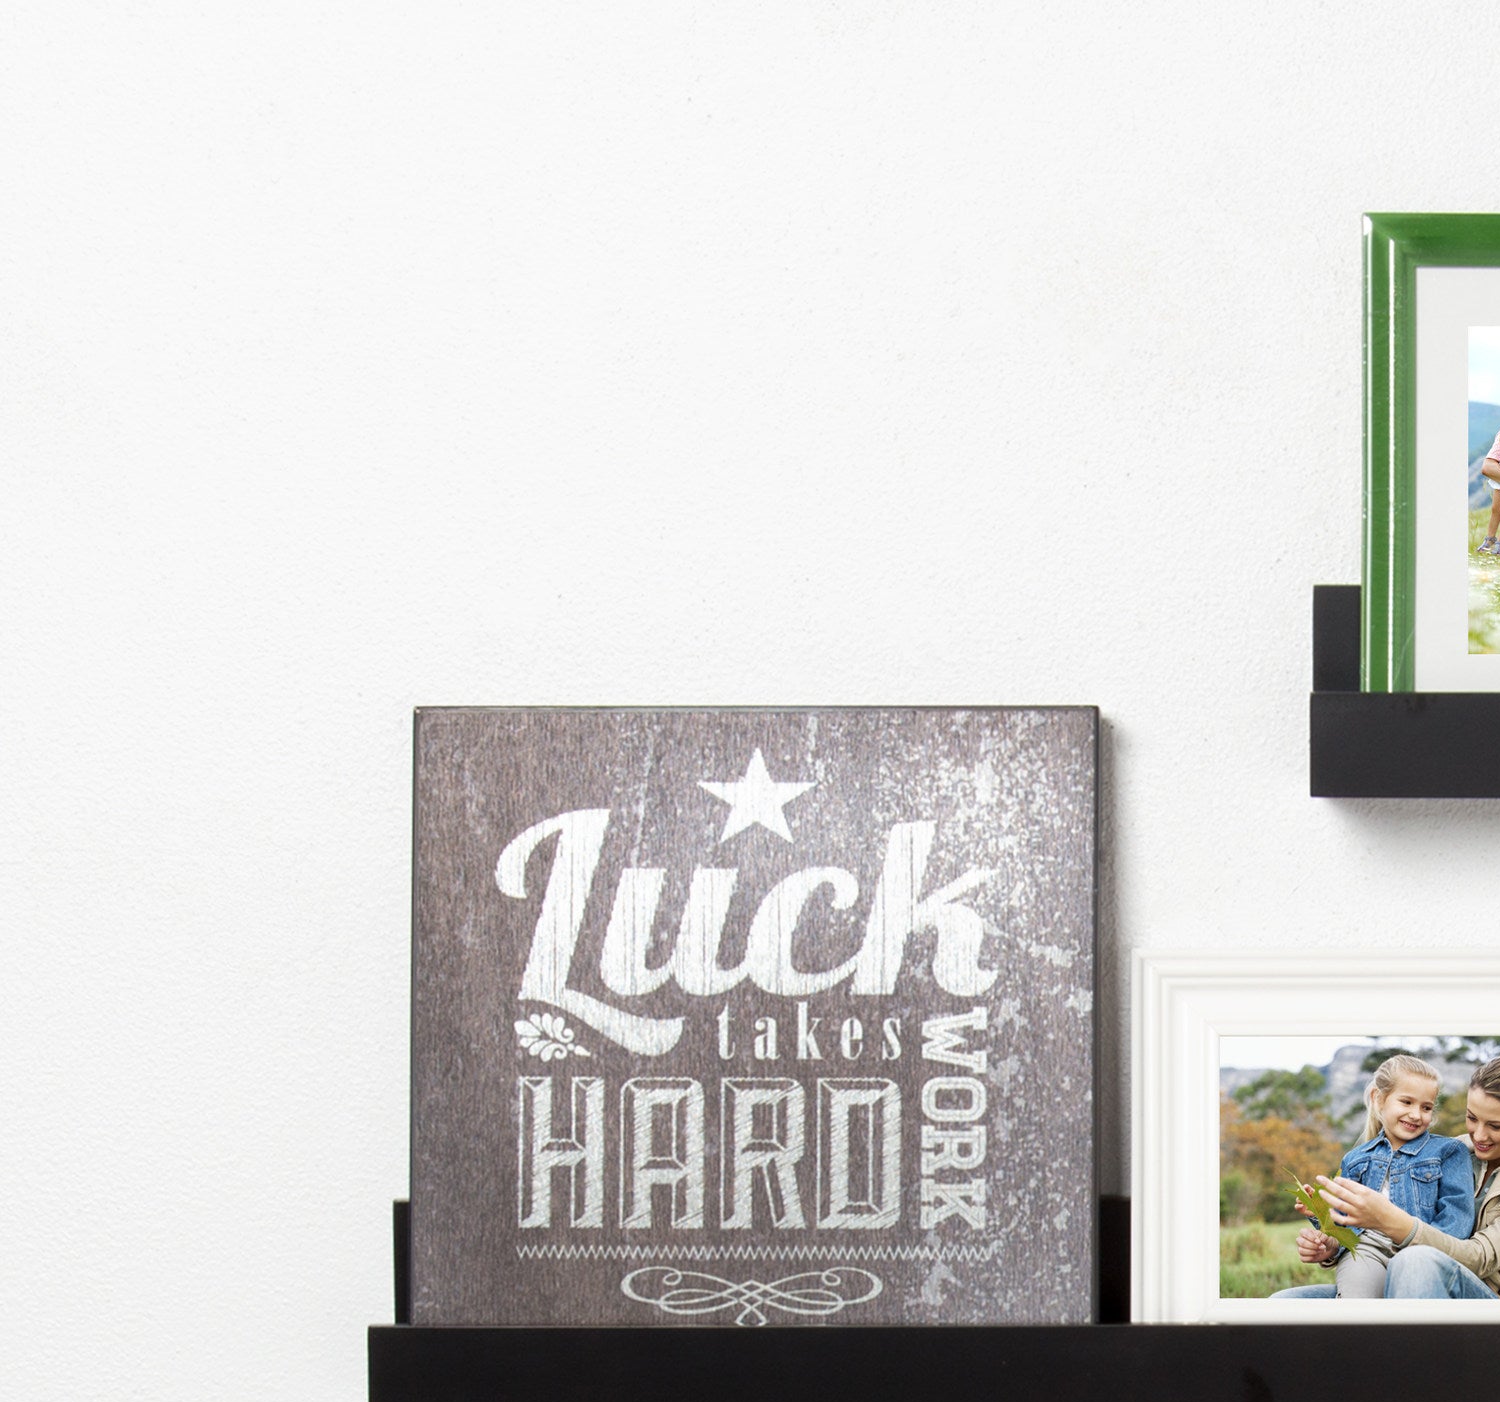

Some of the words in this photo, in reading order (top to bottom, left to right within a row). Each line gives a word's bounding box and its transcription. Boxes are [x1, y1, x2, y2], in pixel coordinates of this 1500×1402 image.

[494, 808, 1000, 1057] Luck
[717, 1002, 901, 1061] takes
[920, 1006, 988, 1231] WORK
[517, 1076, 901, 1230] HARD
